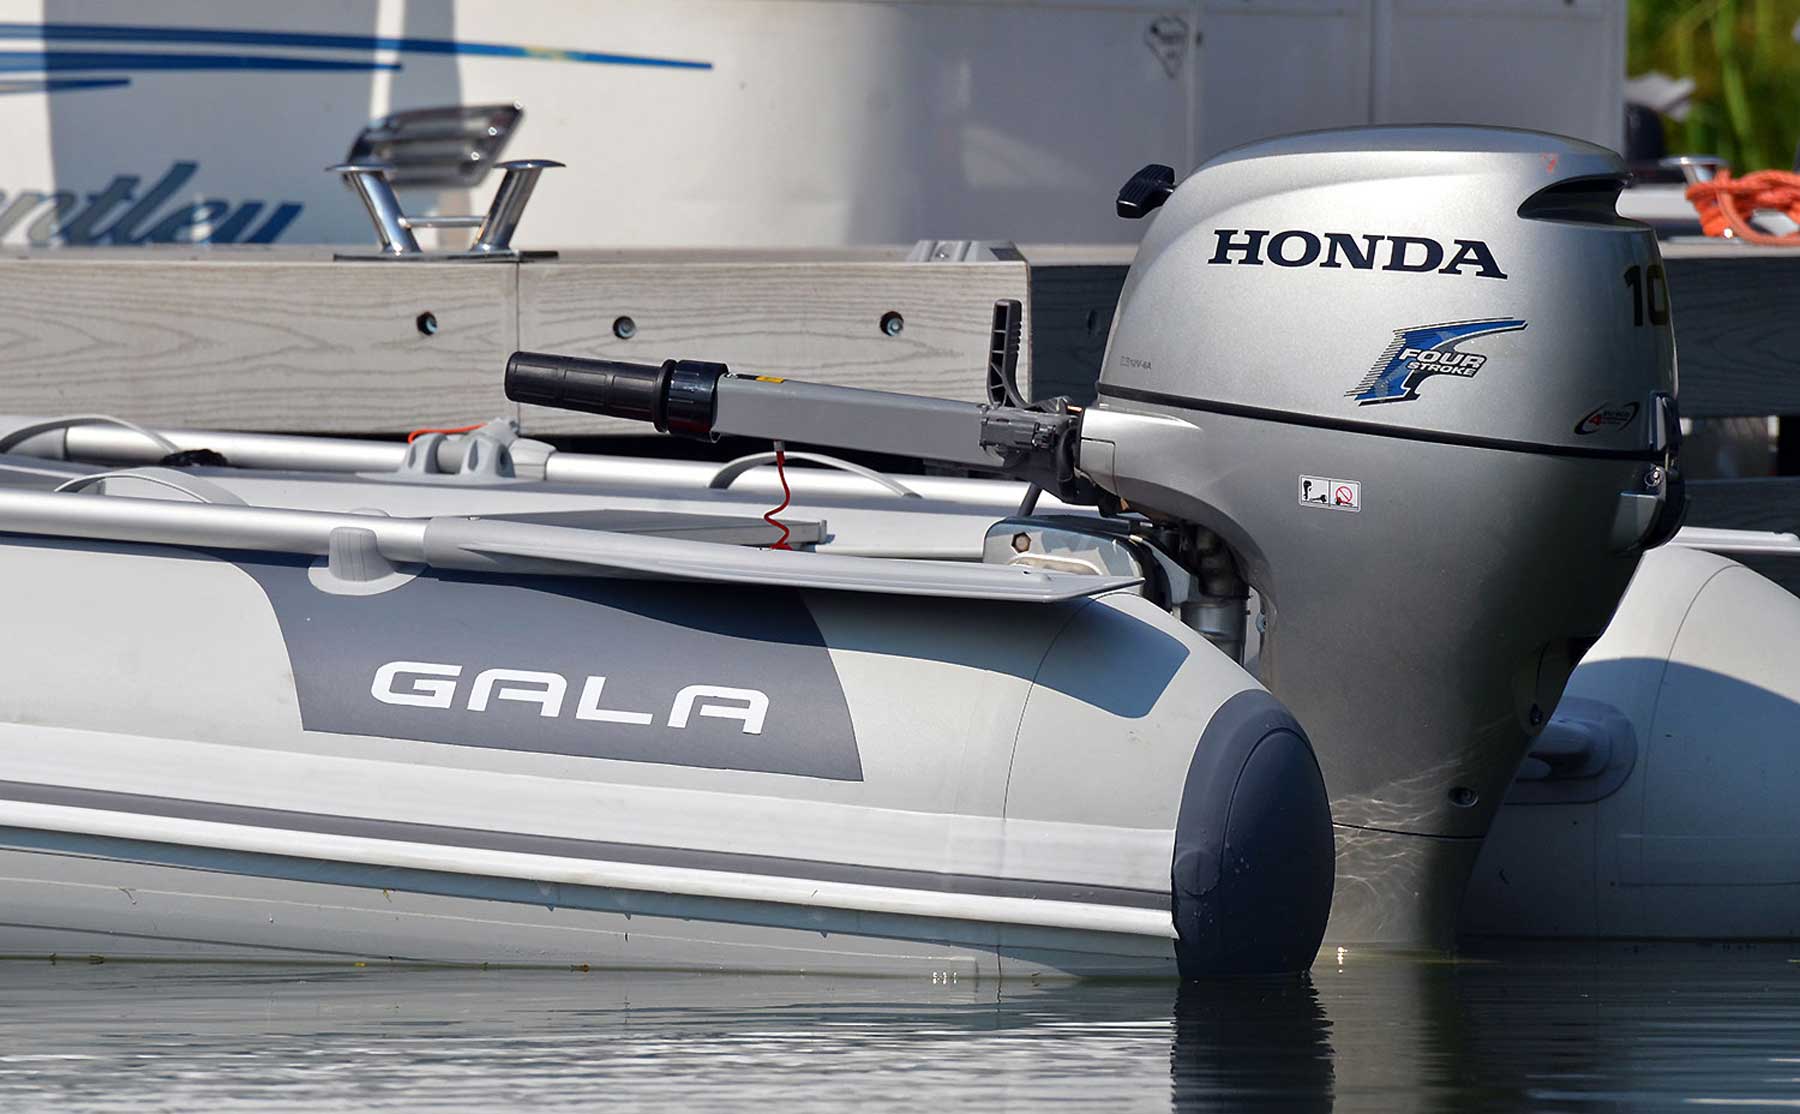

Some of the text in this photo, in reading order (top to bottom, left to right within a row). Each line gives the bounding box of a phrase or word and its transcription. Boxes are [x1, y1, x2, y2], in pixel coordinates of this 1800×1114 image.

[0, 160, 303, 244] ntley
[1207, 229, 1508, 279] HONDA
[1624, 265, 1669, 327] 10
[1400, 348, 1485, 367] FOUR
[1408, 361, 1476, 376] STROKE
[371, 661, 769, 735] GALA
